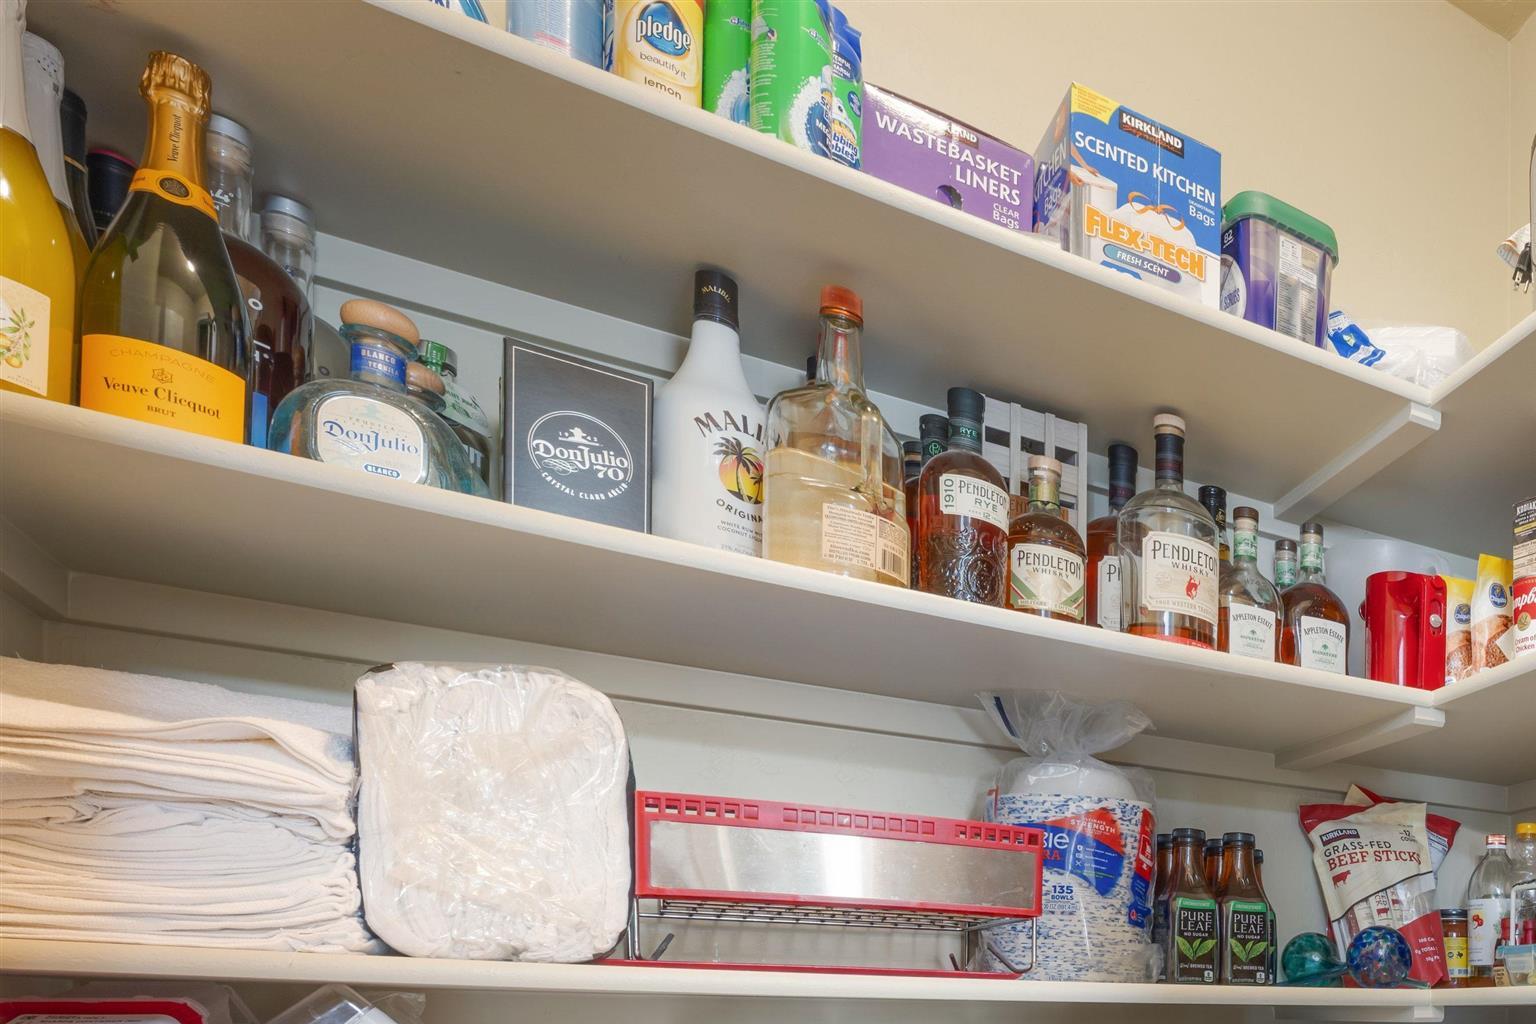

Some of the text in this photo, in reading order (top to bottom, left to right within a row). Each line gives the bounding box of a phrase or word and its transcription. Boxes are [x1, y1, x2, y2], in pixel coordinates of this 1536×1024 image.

[635, 17, 691, 56] pledge
[644, 76, 682, 100] lemon
[1122, 112, 1182, 150] KIRKLAND
[876, 112, 1022, 186] WASTEBASKET
[1074, 131, 1216, 207] SCENTED KITCHEN
[956, 165, 1021, 206] LINERS
[992, 202, 1019, 219] CLEAR
[1189, 205, 1215, 227] Bags
[992, 212, 1019, 230] Bags
[1084, 204, 1207, 281] FLEX-TECH
[1224, 230, 1233, 243] 82
[1117, 250, 1169, 278] FRESH SCENT
[361, 349, 396, 364] BLANCO
[110, 349, 216, 383] CHAMPAGNE
[368, 360, 399, 376] TEQUILA
[103, 376, 222, 420] Veuve Clicquot
[147, 405, 176, 417] BRUT
[959, 426, 977, 438] RYE
[367, 465, 399, 477] BLANCO
[594, 464, 625, 480] 70
[541, 472, 605, 500] CRYSTAL CLARO
[943, 478, 954, 509] 1910
[958, 480, 1008, 506] PENDLETON
[974, 498, 998, 512] RYE
[1517, 501, 1536, 515] KODIAK
[1016, 550, 1082, 580] PENDLETON
[1152, 540, 1218, 572] PENDLETON
[1032, 566, 1070, 580] WHISKY
[1171, 560, 1210, 578] WHISKY
[1232, 613, 1273, 630] APPLETON ESTATE
[1303, 626, 1344, 644] APPLETON ESTATE
[1070, 820, 1115, 833] STRENGTH
[1321, 829, 1358, 842] KIRKLAND
[1324, 841, 1392, 857] GRASS-FED
[1327, 850, 1422, 871] BEEF STICKS
[1052, 886, 1073, 894] 135
[1181, 911, 1212, 921] PURE
[1234, 914, 1264, 924] PURE
